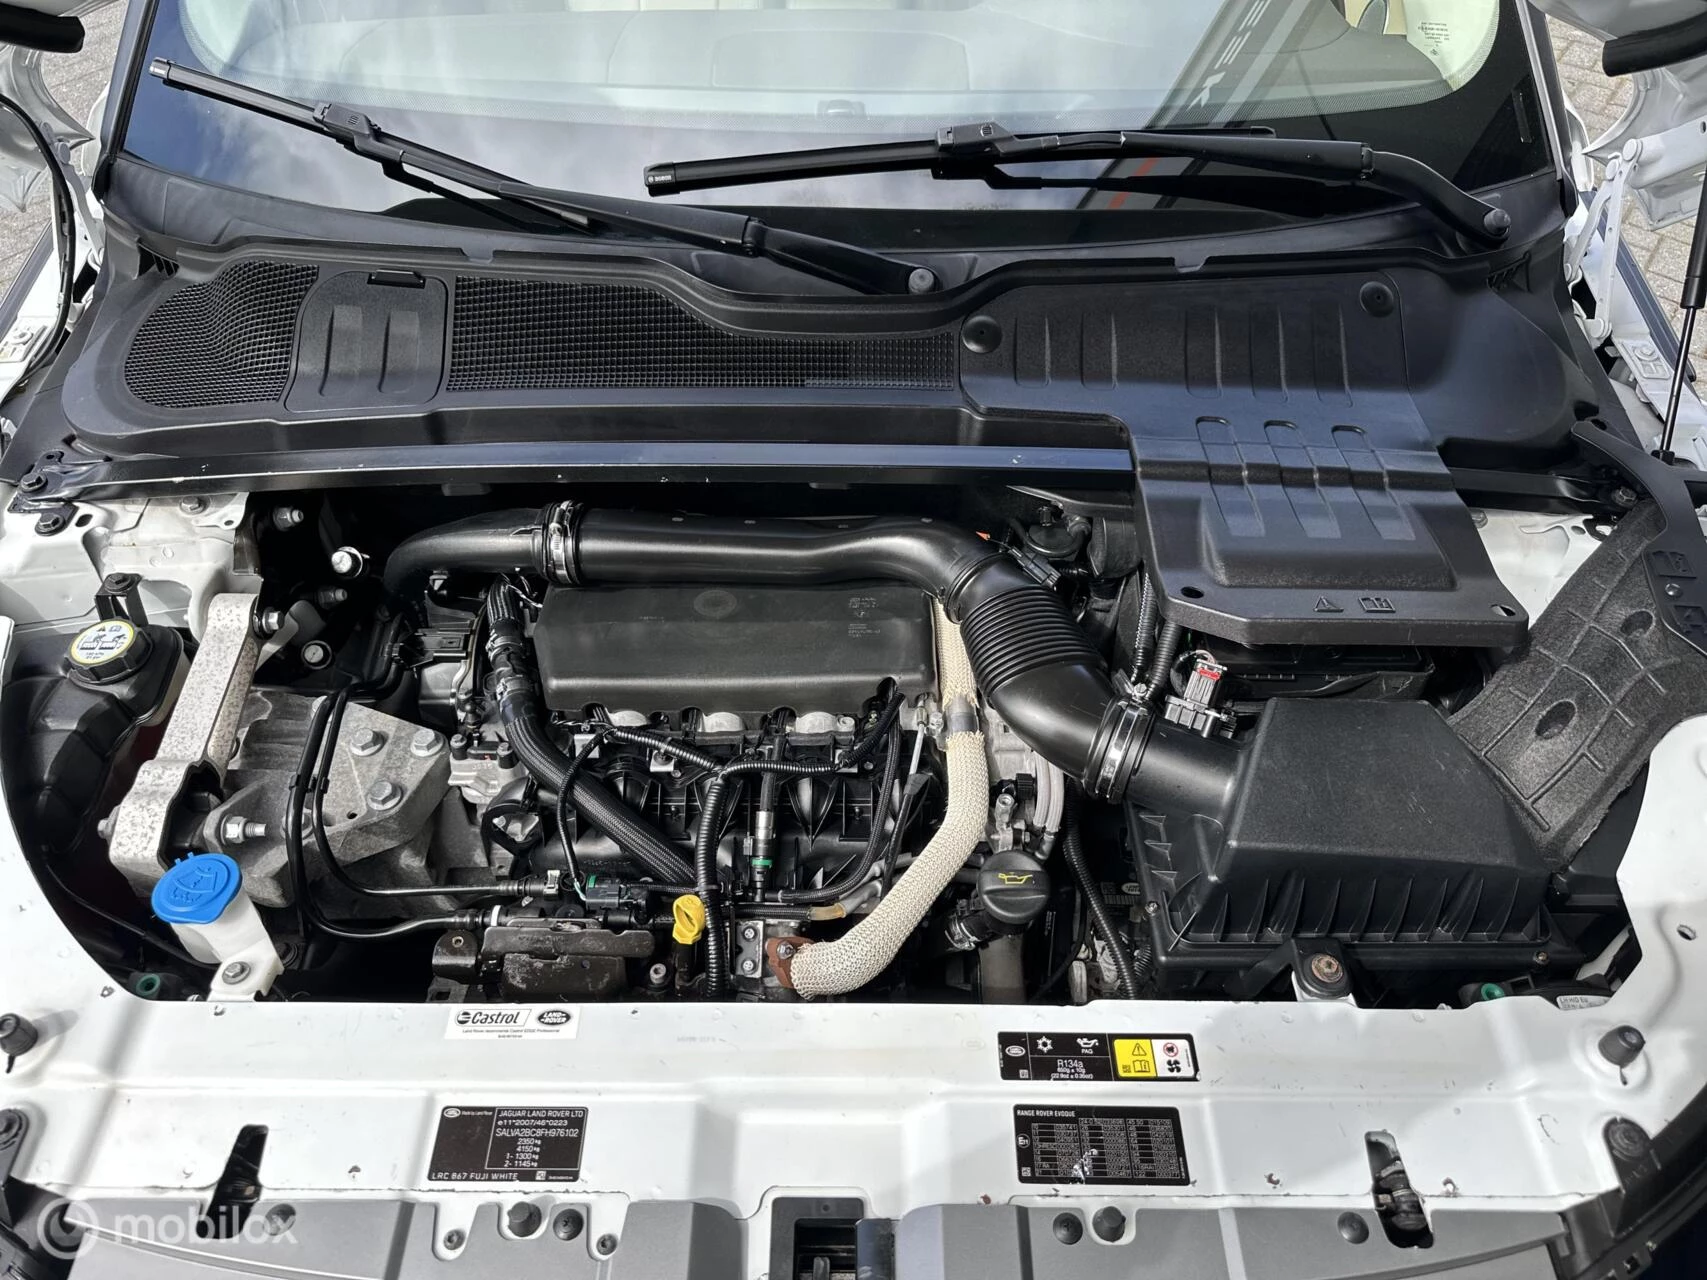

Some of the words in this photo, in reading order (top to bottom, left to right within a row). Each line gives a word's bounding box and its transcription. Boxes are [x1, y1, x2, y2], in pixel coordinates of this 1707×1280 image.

[472, 1012, 520, 1024] Castrol
[1057, 1060, 1084, 1068] R134a
[496, 1128, 579, 1137] SALVA2BC8FH976102
